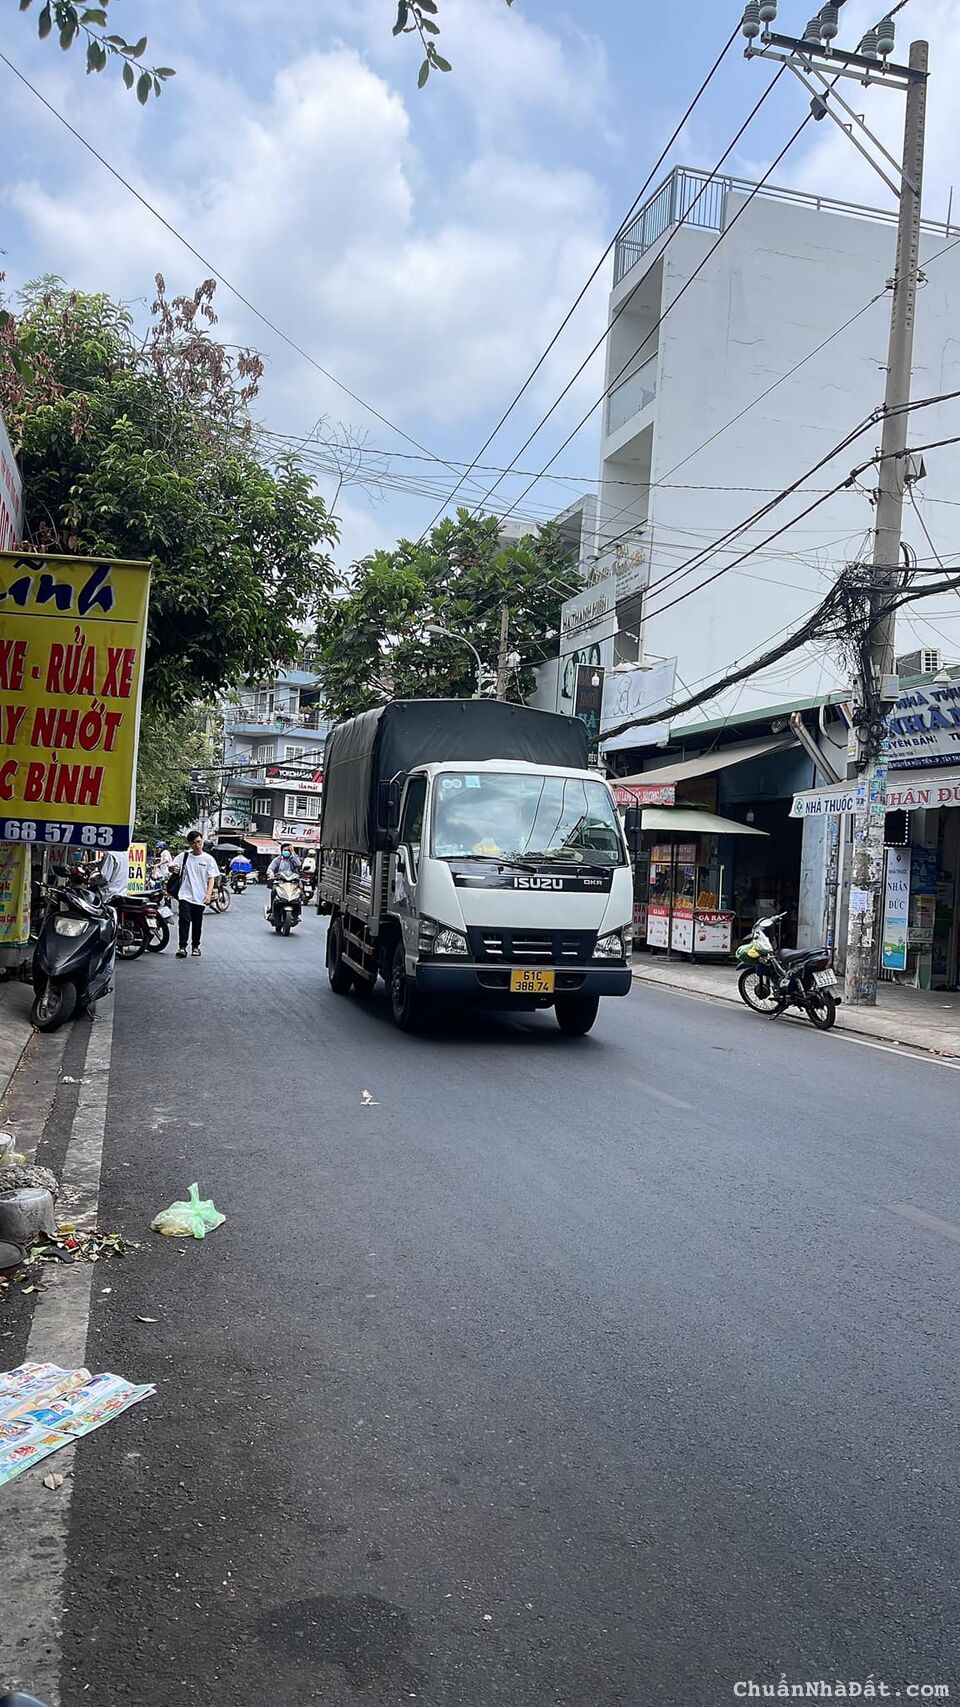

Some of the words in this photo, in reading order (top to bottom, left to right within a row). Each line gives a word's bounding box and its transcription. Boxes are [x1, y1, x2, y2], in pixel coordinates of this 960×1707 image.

[0, 640, 27, 690] XE
[46, 625, 96, 695] RỬA
[101, 648, 136, 697] XE
[31, 698, 123, 751] NHỚT
[24, 751, 105, 806] BÌNH
[805, 798, 821, 813] NHÀ
[824, 794, 852, 811] THUỐC
[4, 820, 37, 840] 68
[45, 823, 74, 843] 57
[81, 825, 113, 846] 83
[281, 826, 297, 835] ZIC
[128, 864, 143, 879] GÀ
[513, 877, 563, 890] ISUZU
[887, 880, 908, 891] NHÂN
[888, 898, 905, 910] ĐỨC
[523, 971, 542, 981] 61C
[515, 981, 549, 992] 388.74
